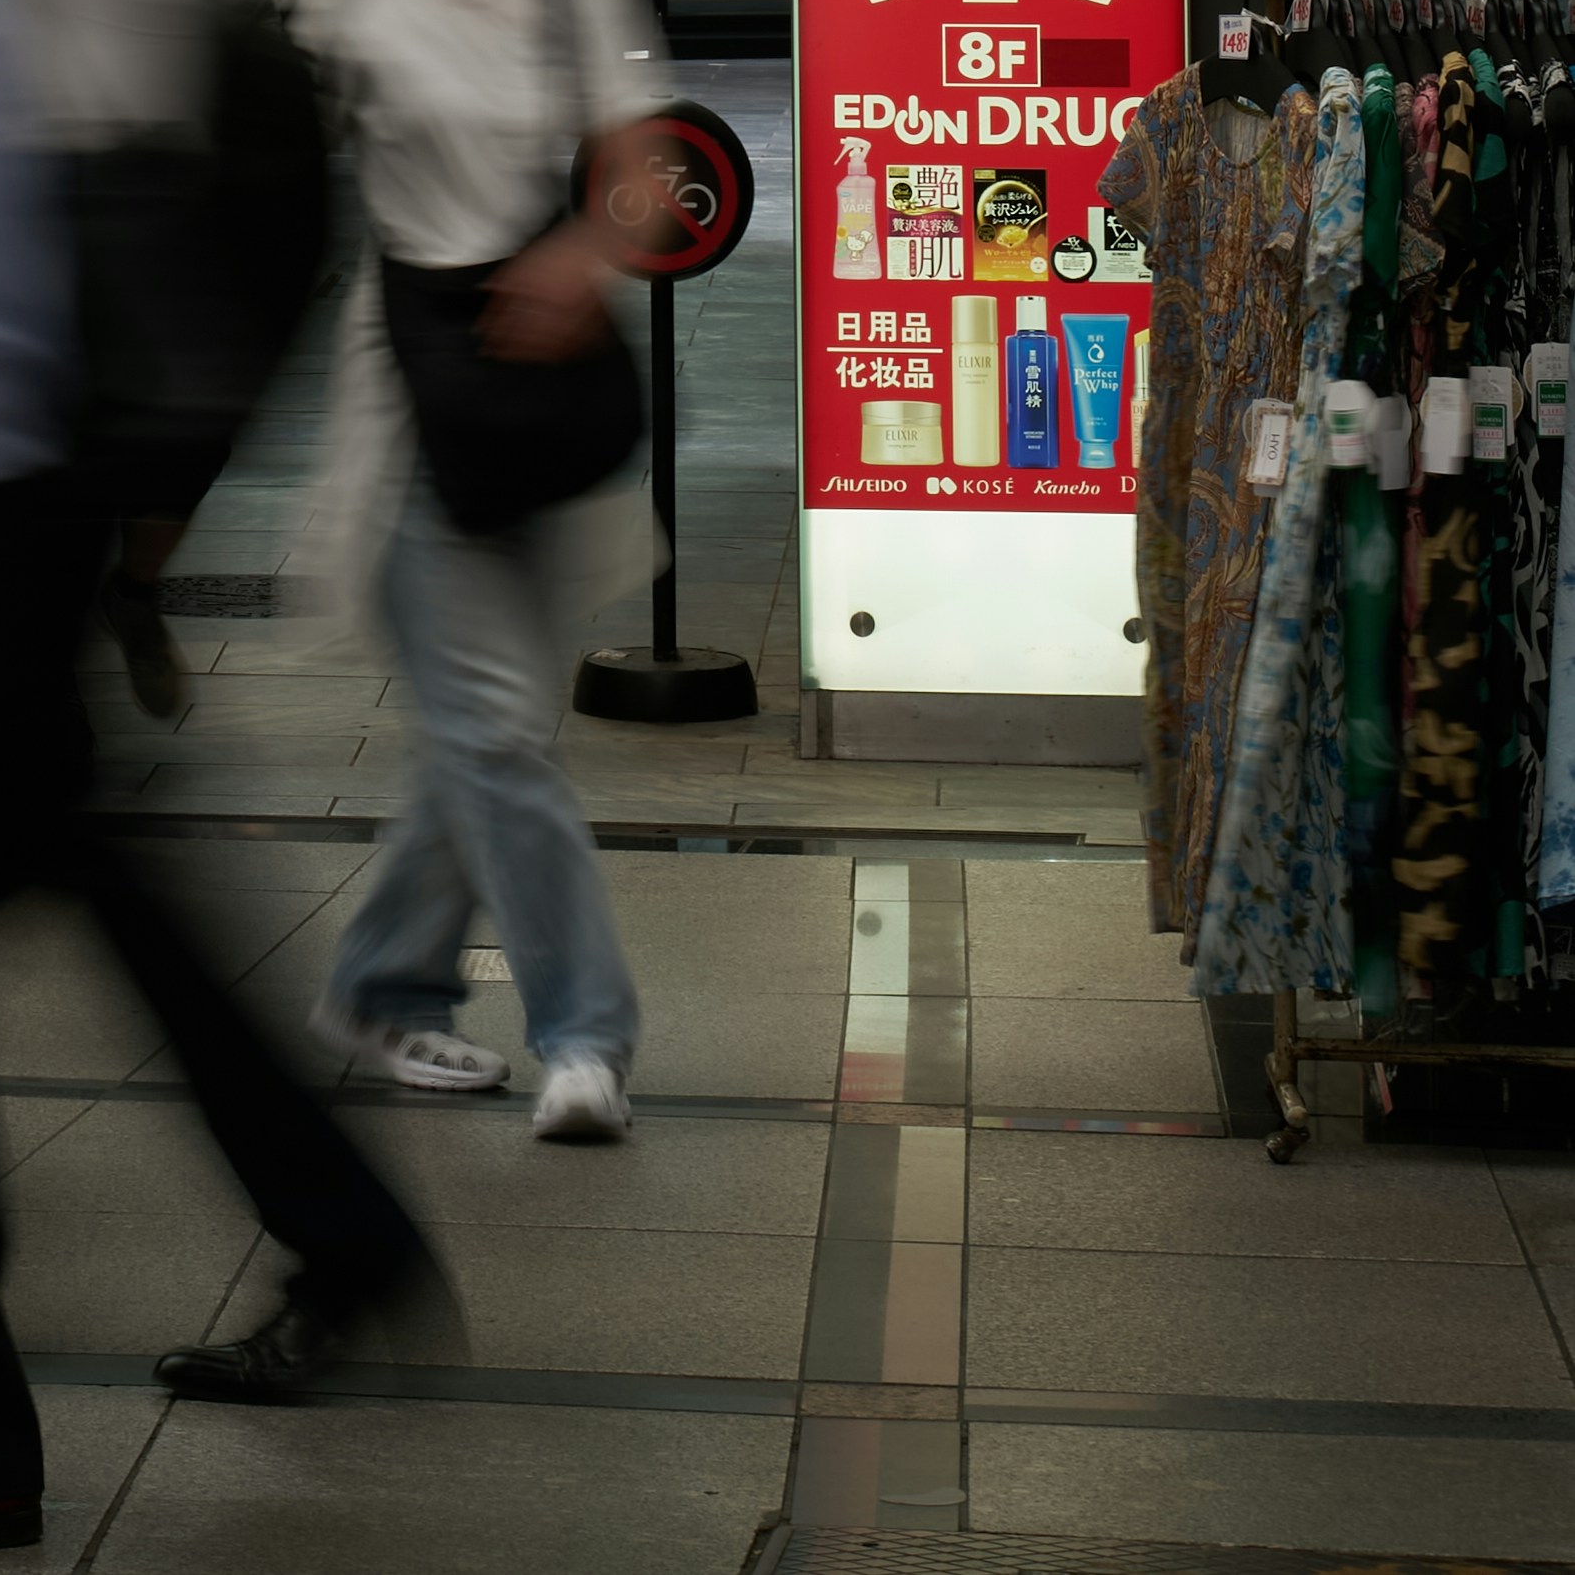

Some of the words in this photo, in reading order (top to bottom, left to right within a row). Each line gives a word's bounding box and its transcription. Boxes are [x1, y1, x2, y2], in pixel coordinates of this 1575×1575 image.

[1222, 32, 1249, 53] 1485
[957, 32, 1027, 80] 8F
[837, 312, 932, 344] 日用品
[958, 355, 992, 369] ELIXIR
[836, 357, 934, 389] 化妆品
[1074, 368, 1117, 385] Perfect
[1084, 378, 1119, 394] Whip
[885, 429, 918, 442] ELIXIR
[820, 476, 907, 493] SHISEIDO
[963, 477, 1015, 495] KOSÉ
[1034, 479, 1101, 495] Kanebo
